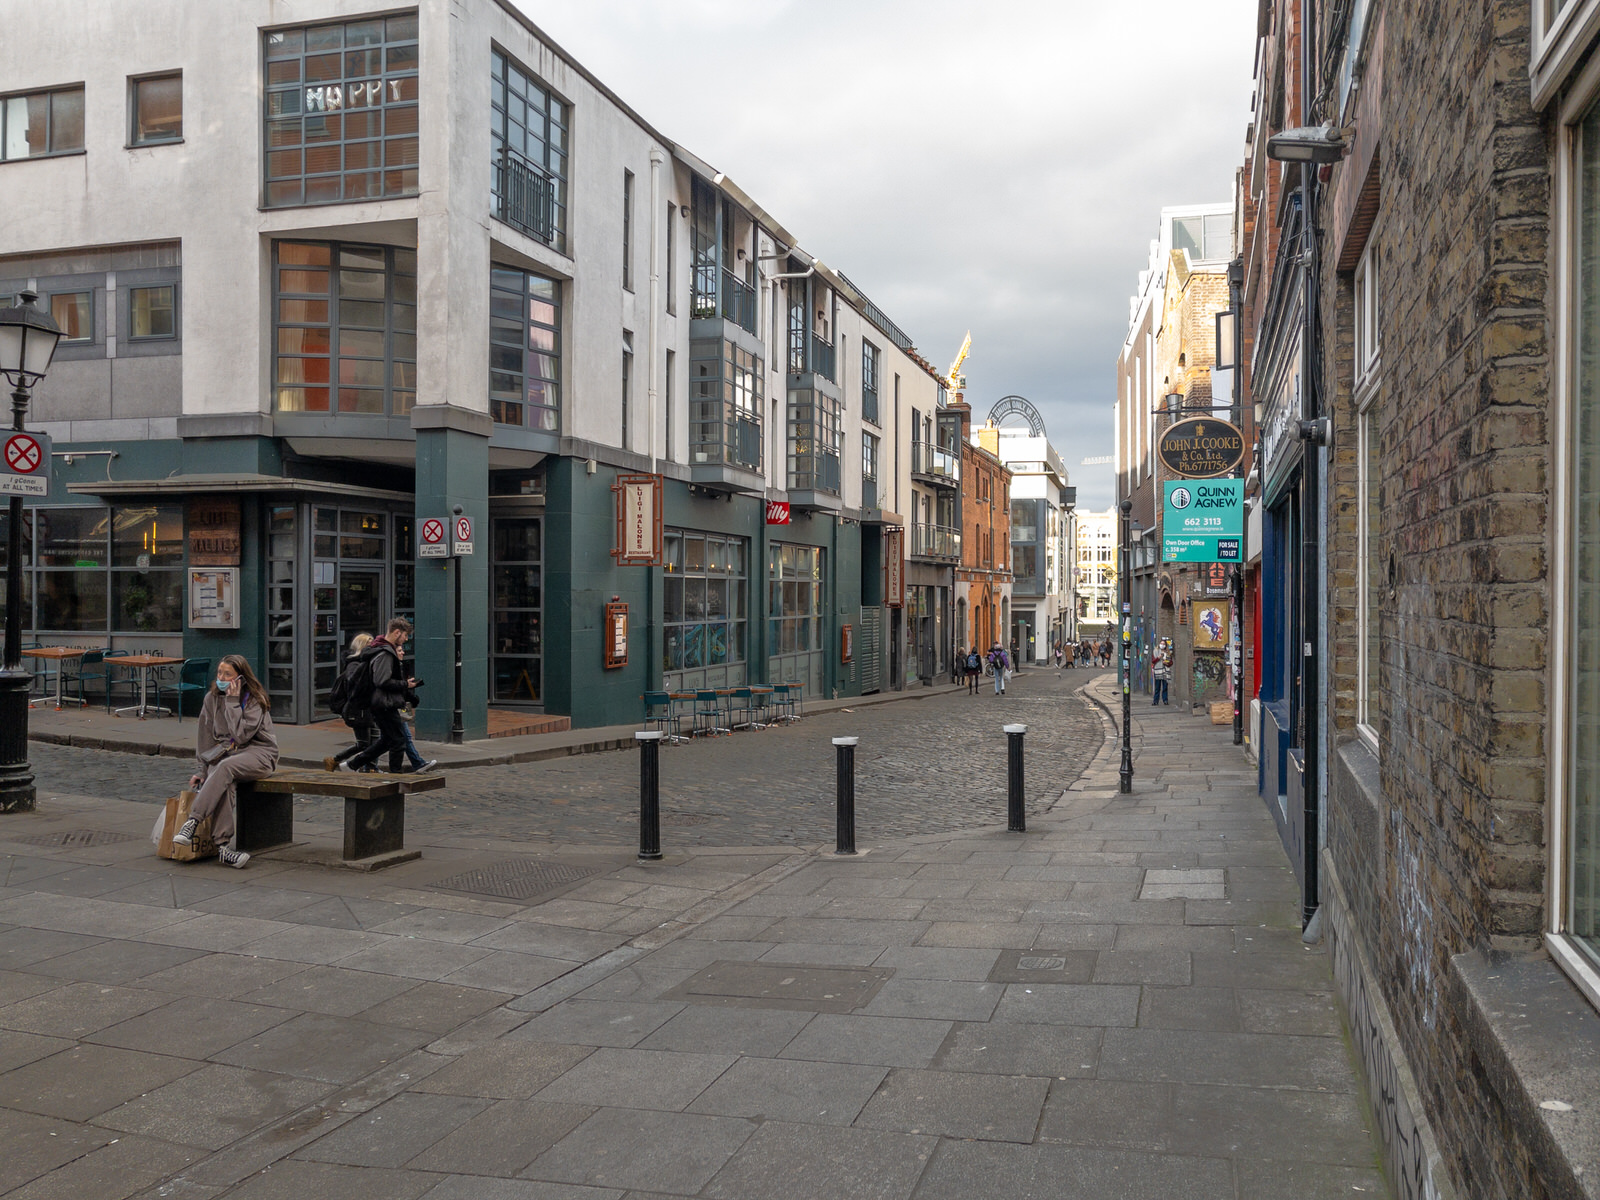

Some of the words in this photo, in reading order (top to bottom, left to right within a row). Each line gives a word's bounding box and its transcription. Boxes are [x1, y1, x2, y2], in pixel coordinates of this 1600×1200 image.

[306, 80, 403, 112] HAPPY
[1163, 439, 1190, 451] JOHN
[1193, 438, 1200, 450] J.
[1201, 437, 1239, 449] COOKE
[1182, 451, 1188, 461] &
[1190, 450, 1204, 460] Co.
[1206, 449, 1223, 460] Ltd.
[1197, 486, 1235, 497] QUINN
[1194, 498, 1237, 508] AGNEW
[767, 505, 788, 523] illy
[1184, 518, 1200, 526] 662
[1203, 518, 1222, 526] 3113
